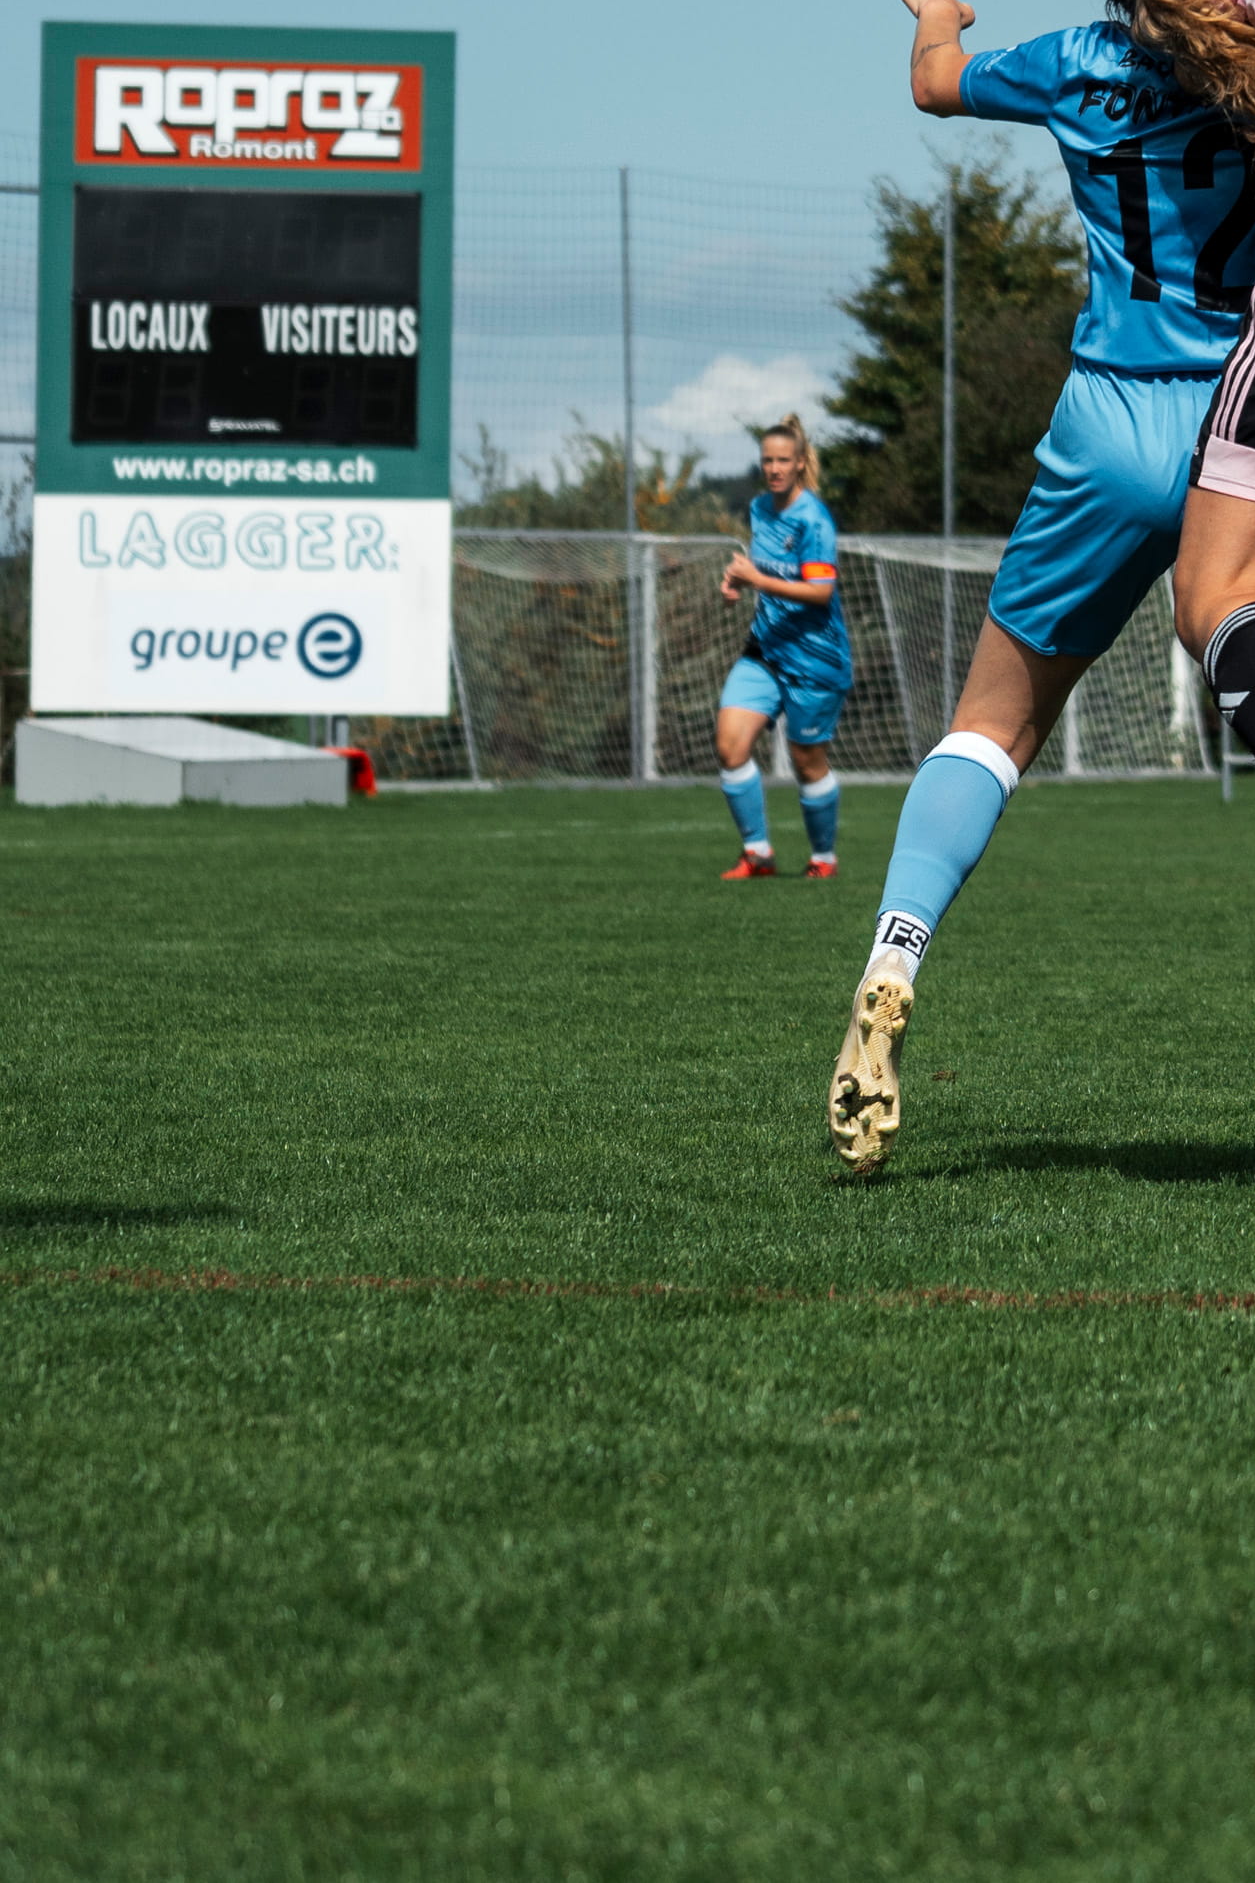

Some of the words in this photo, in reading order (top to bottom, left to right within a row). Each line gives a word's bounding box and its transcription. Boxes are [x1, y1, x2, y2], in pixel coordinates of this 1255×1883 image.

[94, 66, 402, 160] Ropraz
[189, 134, 317, 160] Romont
[91, 302, 210, 351] LOCAUX
[262, 305, 418, 355] VISITEURS
[112, 455, 377, 487] www.ropraz-sa.ch
[79, 511, 386, 571] LAGGER
[130, 628, 288, 672] groupe
[886, 919, 928, 956] FS
